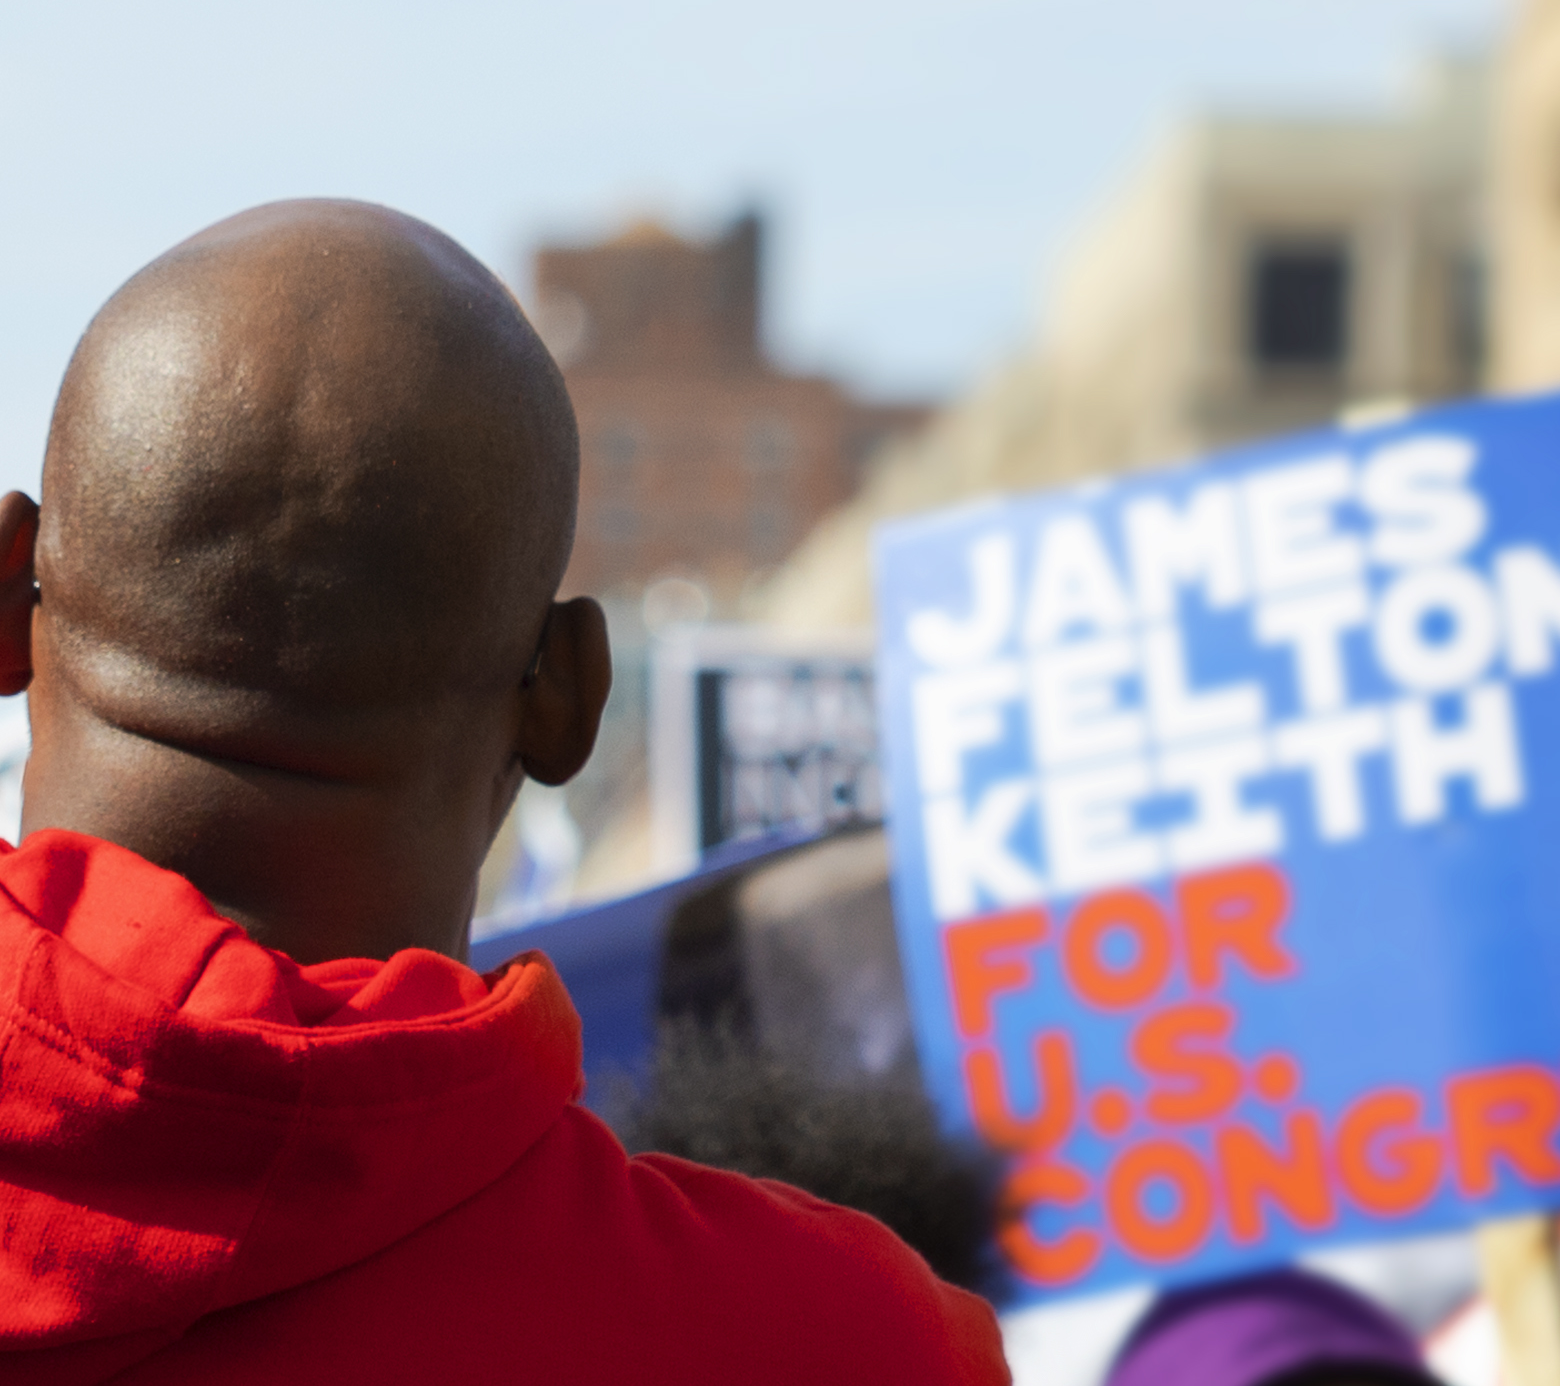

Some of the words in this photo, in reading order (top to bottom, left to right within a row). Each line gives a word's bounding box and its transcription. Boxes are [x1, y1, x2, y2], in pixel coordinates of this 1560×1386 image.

[906, 436, 1485, 663] JAMES
[922, 683, 1526, 921] KEITH
[940, 862, 1296, 1042] FOR
[964, 1003, 1298, 1156] U.S.
